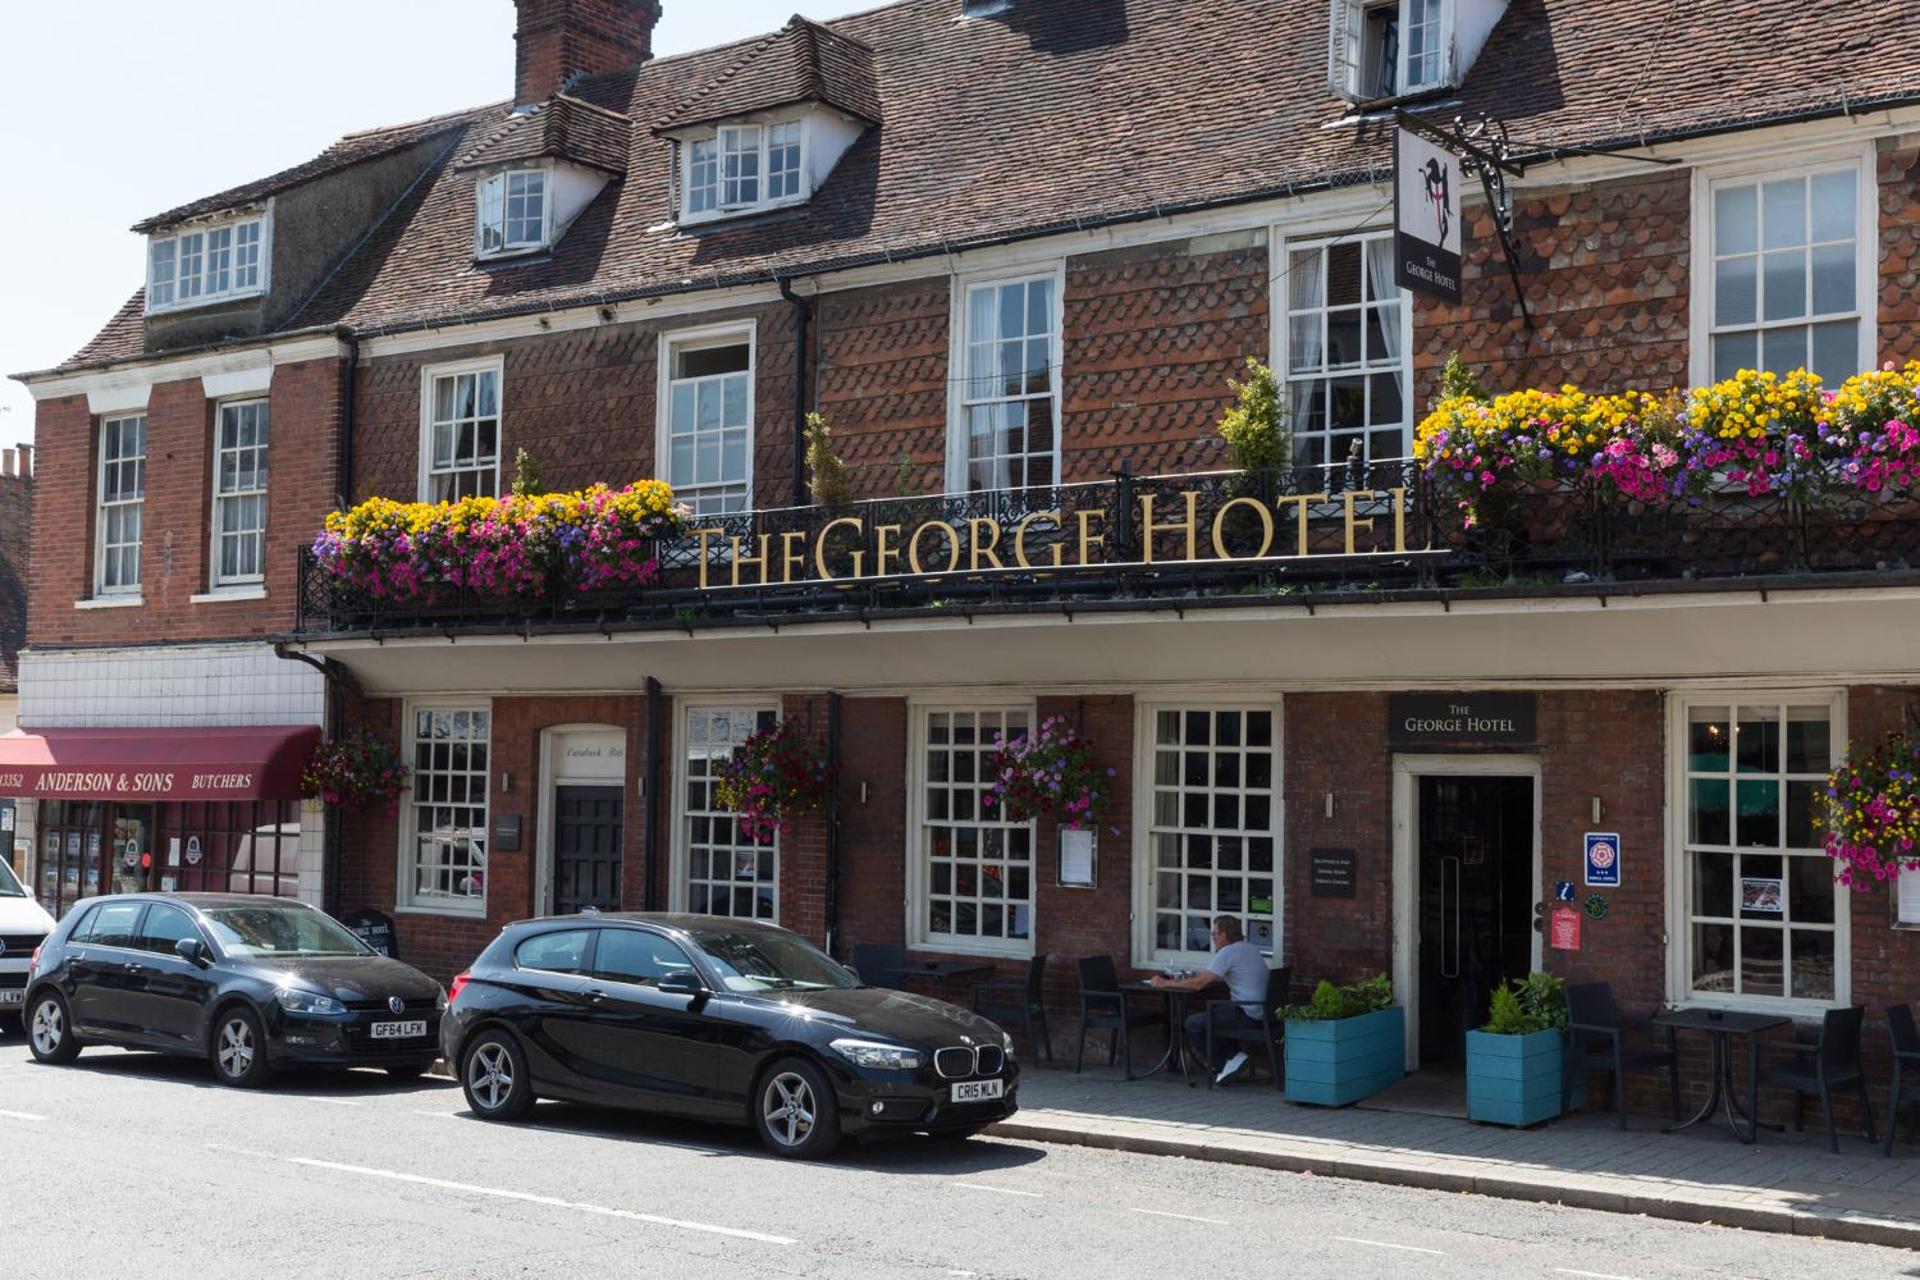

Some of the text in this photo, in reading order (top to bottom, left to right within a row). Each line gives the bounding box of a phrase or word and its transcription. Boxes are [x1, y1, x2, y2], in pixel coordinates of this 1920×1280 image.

[1138, 487, 1433, 563] HOTEL
[1449, 704, 1471, 715] THE
[1405, 717, 1516, 732] GEORGE HOTEL
[34, 772, 114, 792] ANDERSON
[116, 774, 129, 791] &
[132, 773, 174, 791] SONS
[191, 774, 252, 789] BUTCHERS
[375, 1023, 402, 1036] GF64
[958, 1083, 979, 1099] CR15
